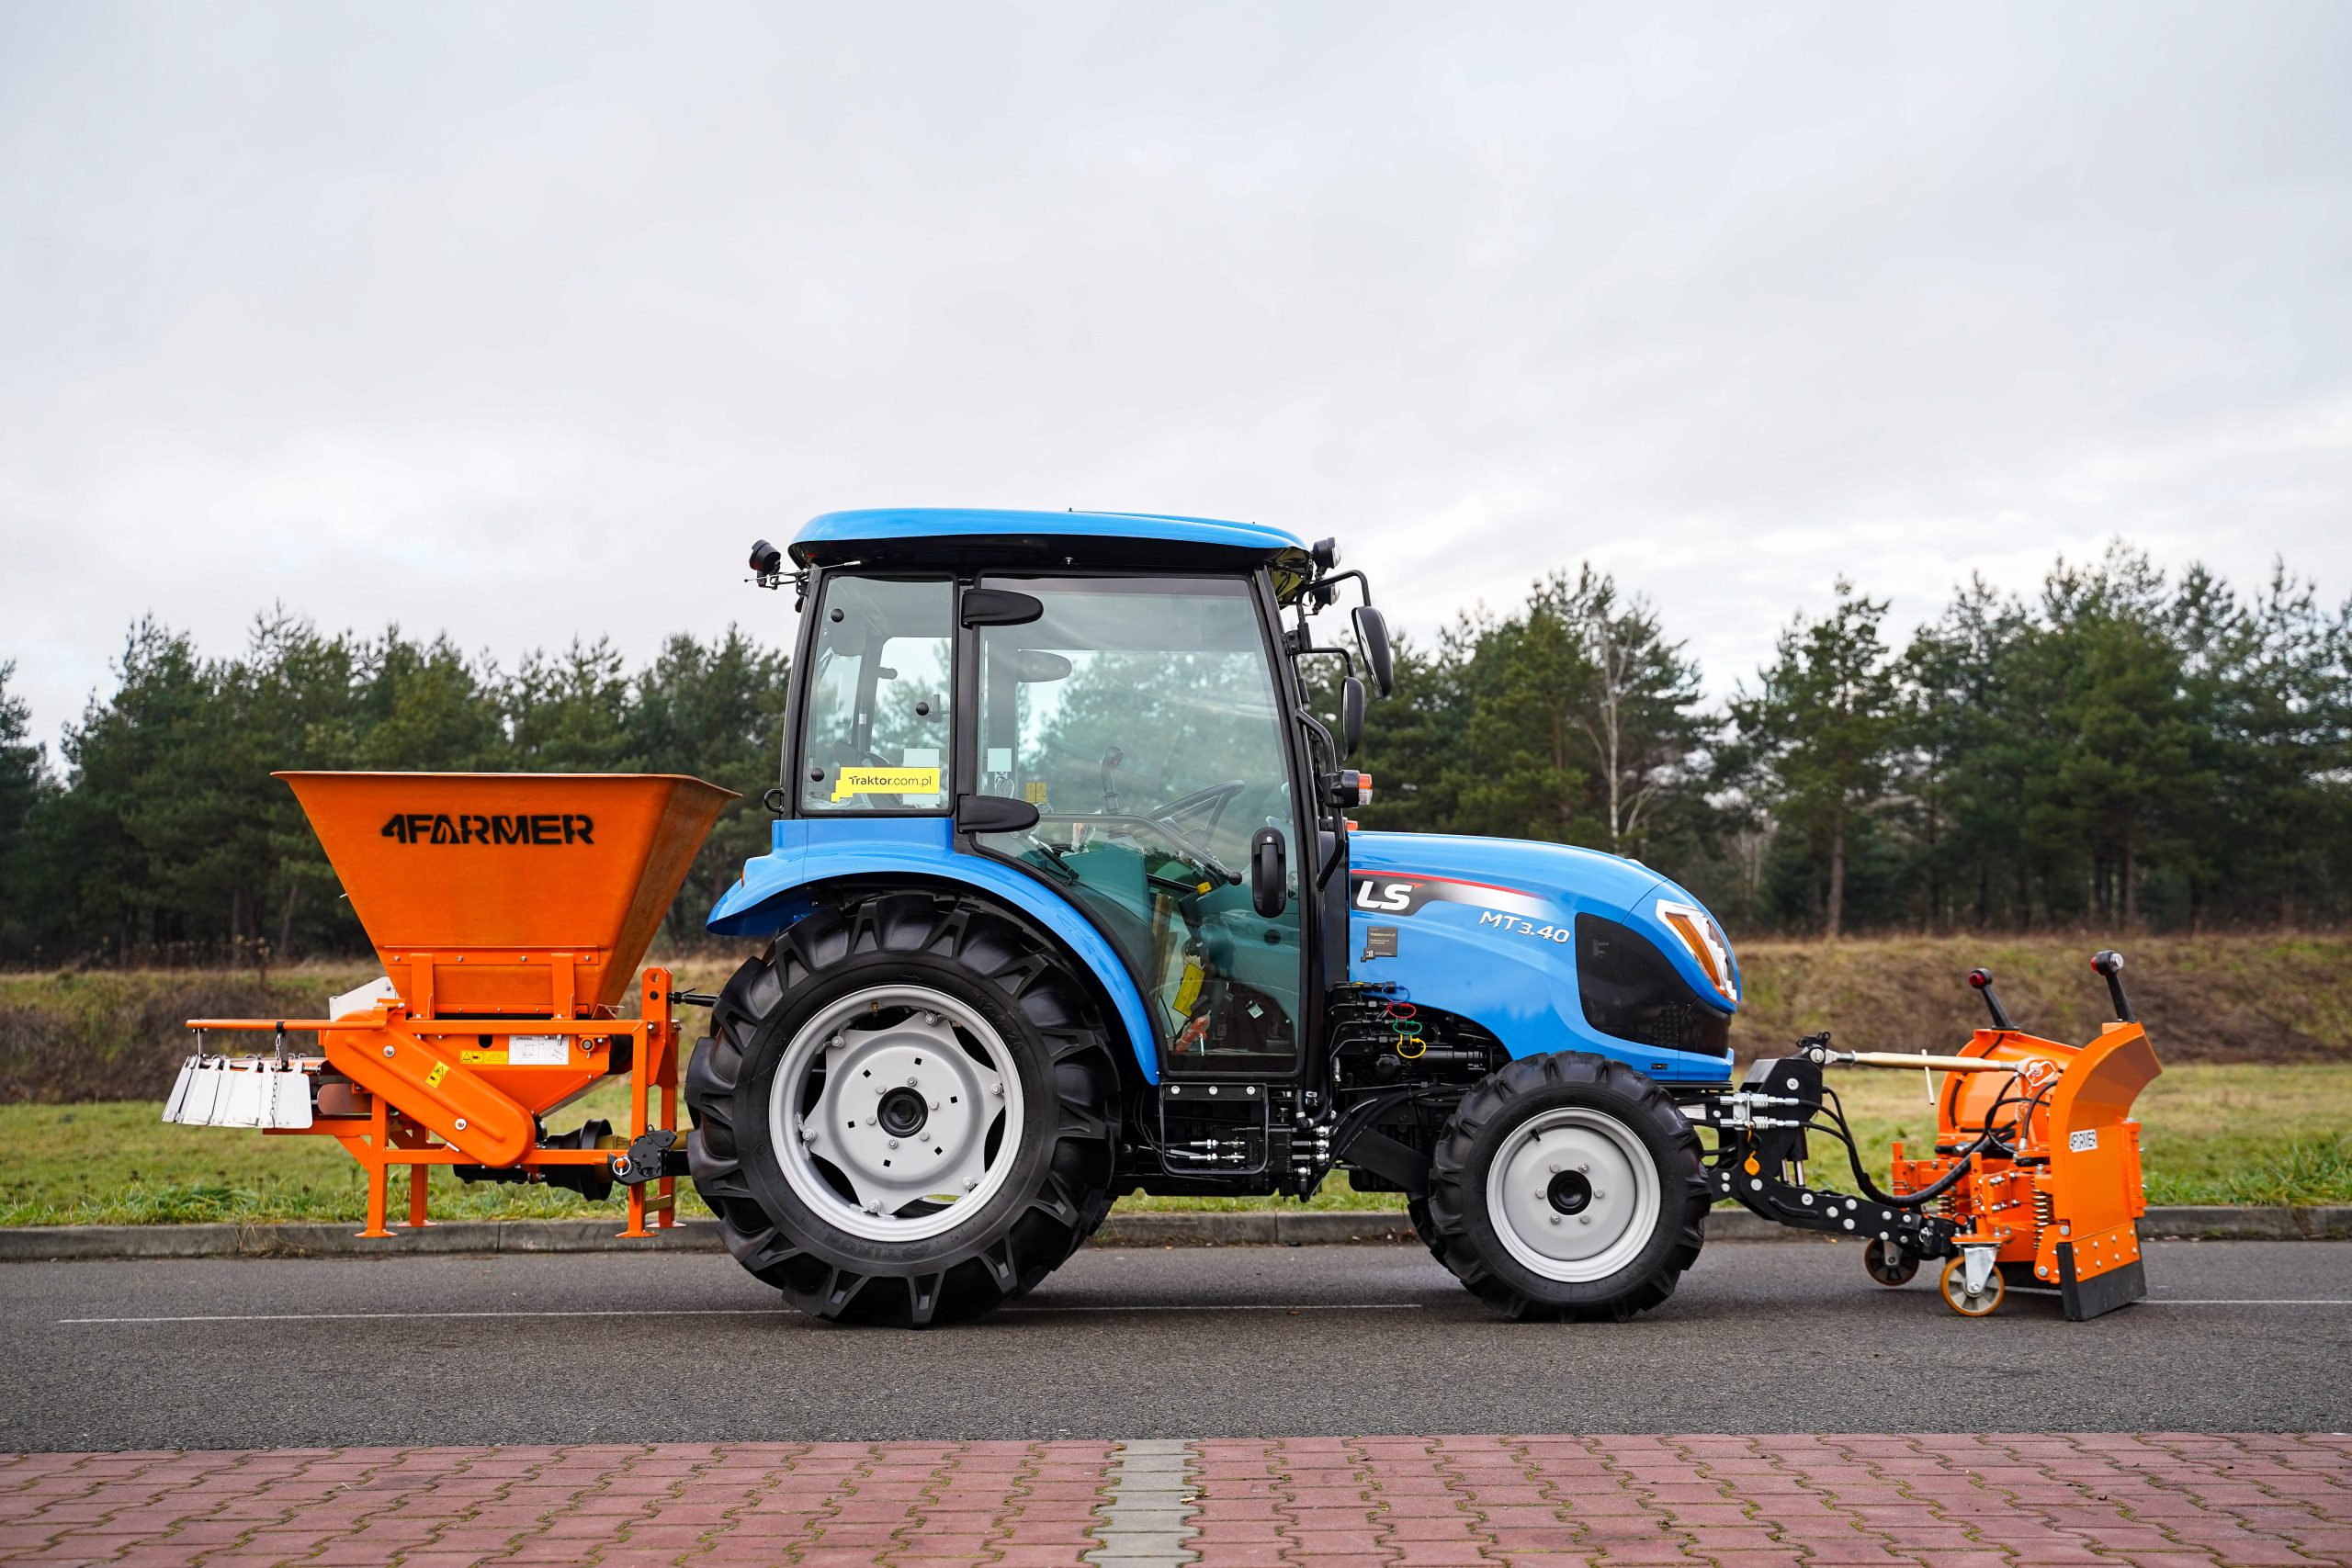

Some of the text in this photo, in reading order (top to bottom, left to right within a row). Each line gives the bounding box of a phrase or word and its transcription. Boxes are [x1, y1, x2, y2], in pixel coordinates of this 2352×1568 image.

[849, 776, 932, 787] Traktor.com.pl
[381, 814, 594, 844] 4FARMER
[1356, 880, 1413, 911] LS
[1478, 910, 1570, 944] MT3.40
